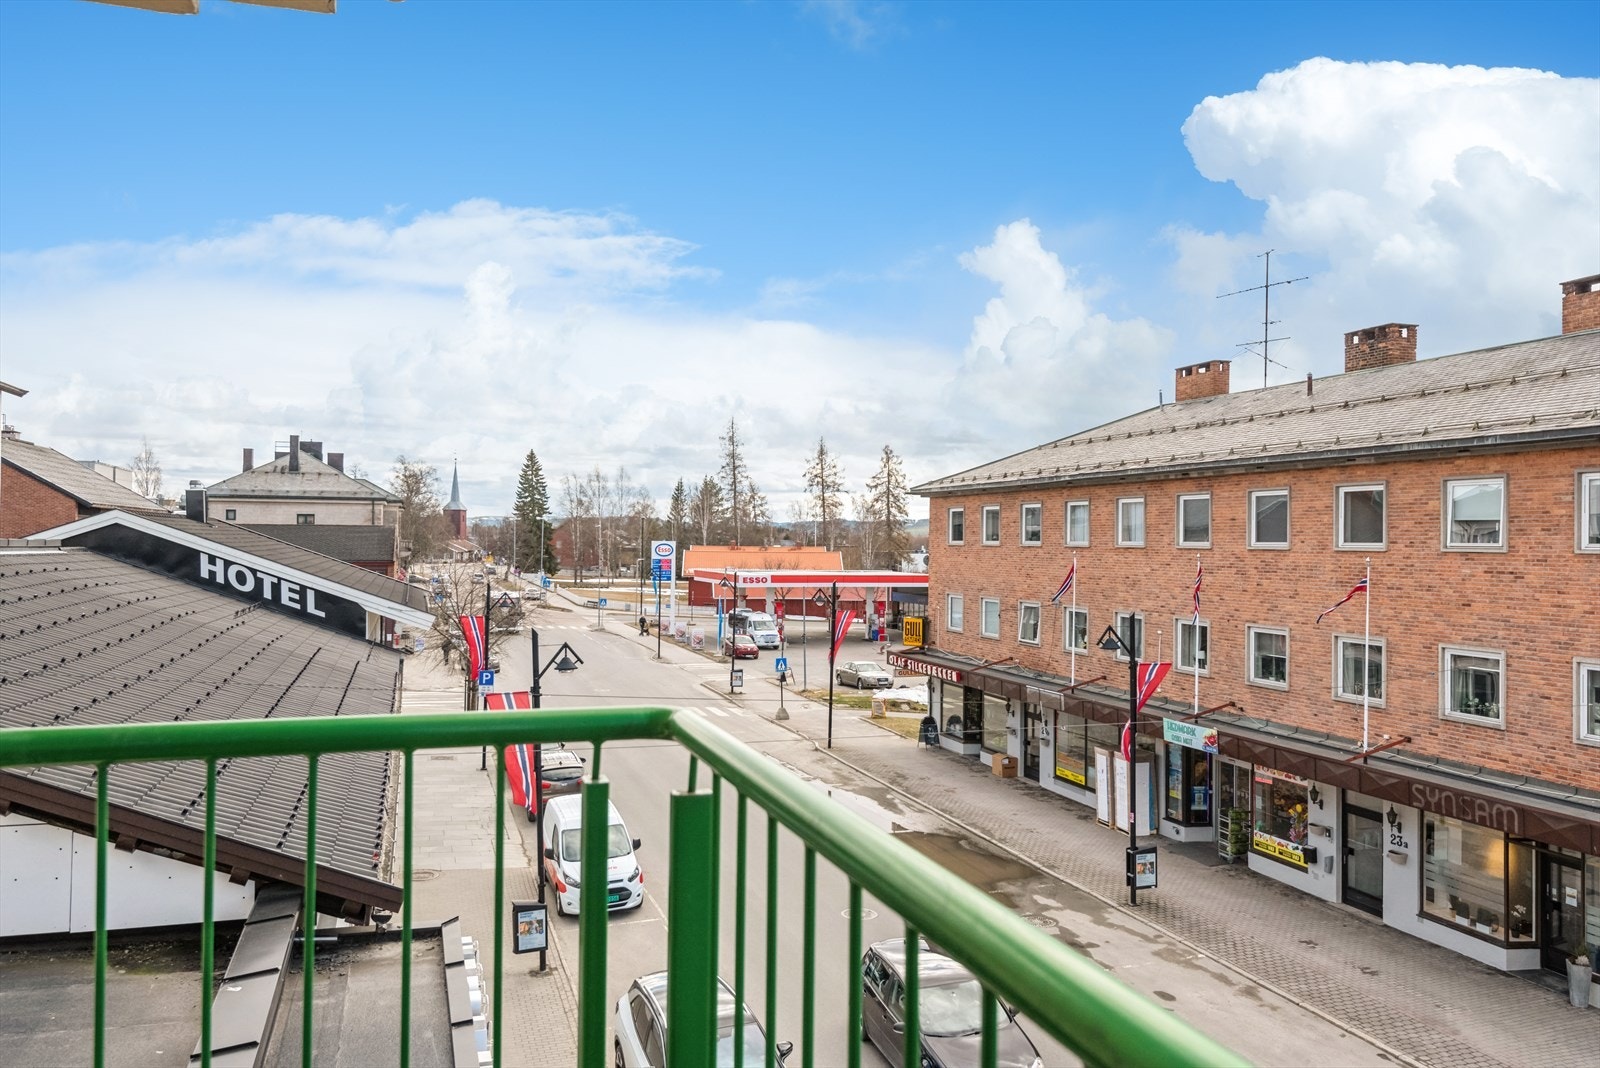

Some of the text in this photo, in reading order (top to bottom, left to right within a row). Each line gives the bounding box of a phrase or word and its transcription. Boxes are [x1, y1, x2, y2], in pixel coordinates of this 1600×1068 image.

[200, 552, 326, 618] HOTEL
[742, 576, 768, 584] ESSO
[904, 621, 921, 637] GULL
[888, 654, 907, 667] OLAF
[482, 672, 491, 684] P
[1411, 783, 1519, 834] SYNSAM
[1390, 833, 1409, 849] 23a
